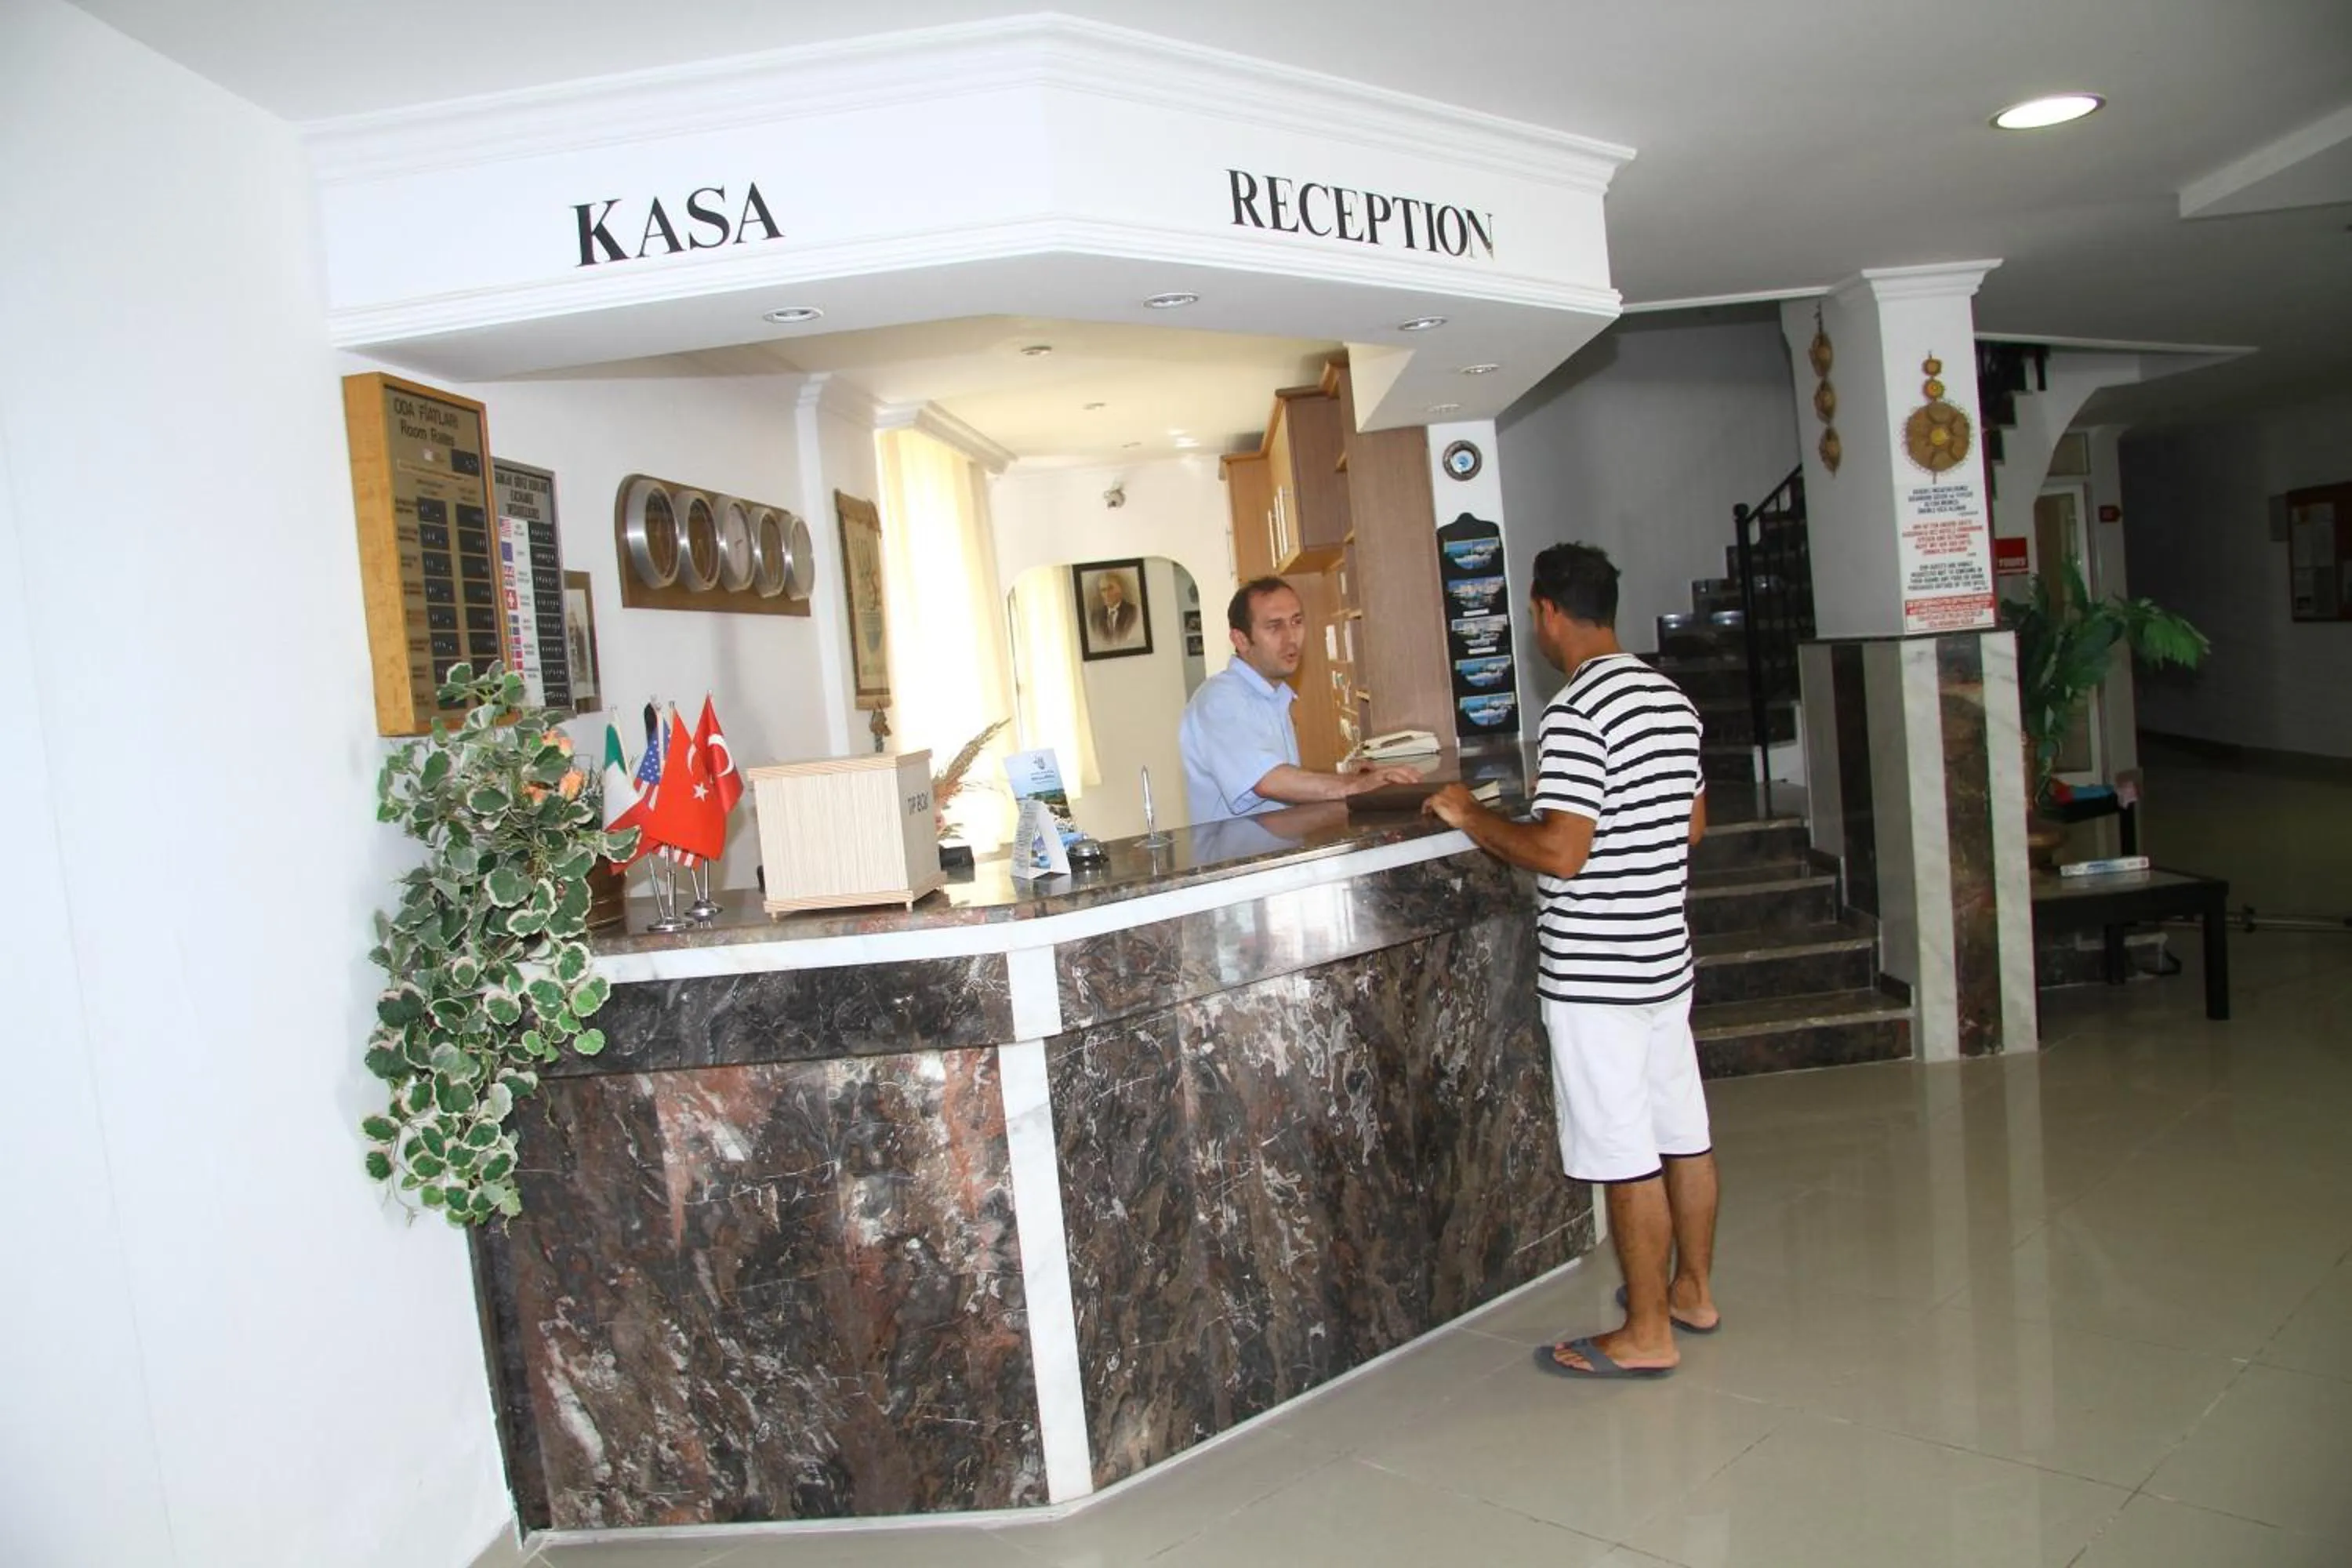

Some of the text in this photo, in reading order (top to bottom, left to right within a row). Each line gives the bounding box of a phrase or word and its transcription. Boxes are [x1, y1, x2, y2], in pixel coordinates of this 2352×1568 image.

[570, 182, 786, 267] KASA
[1226, 169, 1494, 260] RECEPTION
[401, 419, 427, 440] Room
